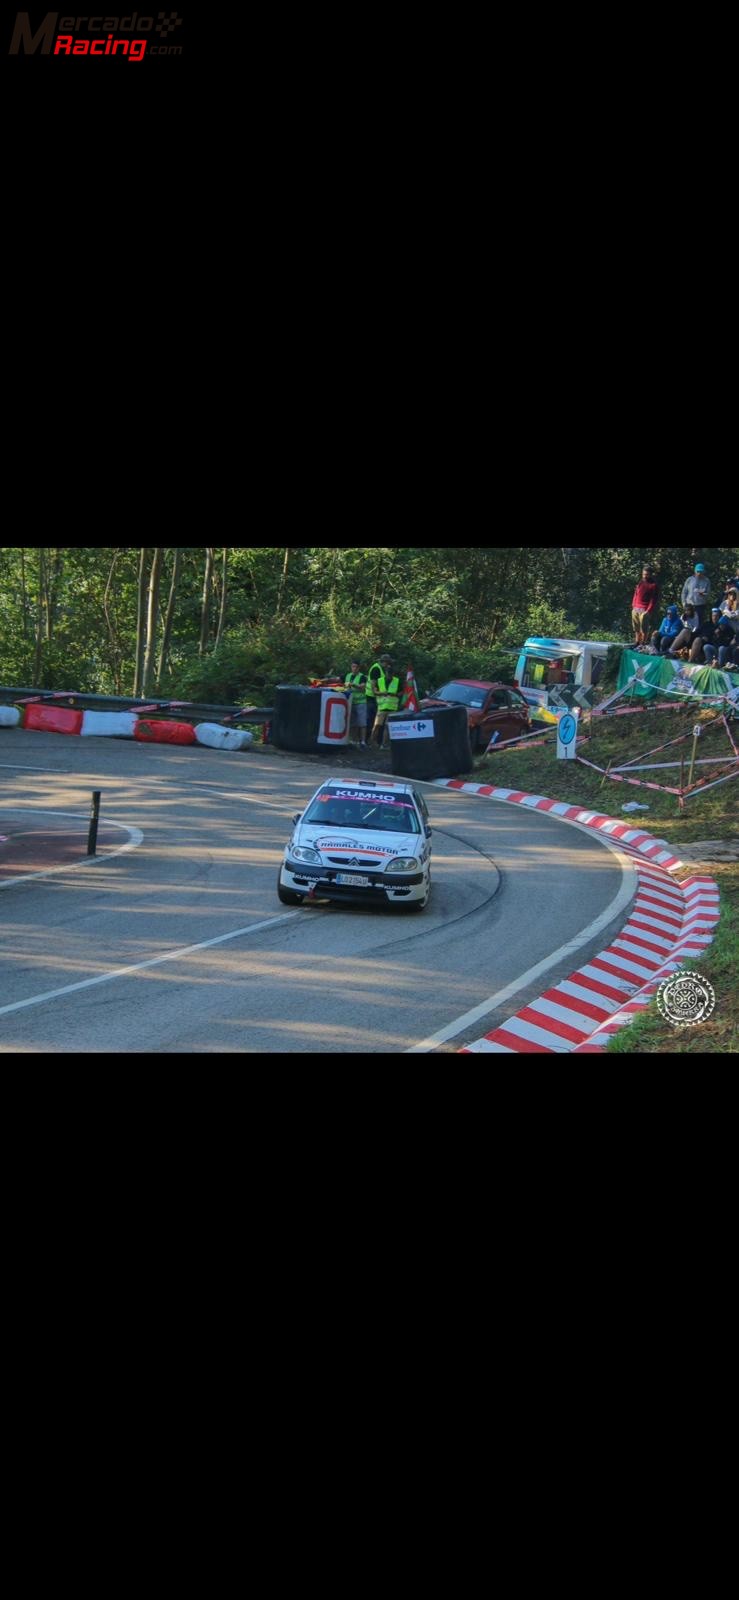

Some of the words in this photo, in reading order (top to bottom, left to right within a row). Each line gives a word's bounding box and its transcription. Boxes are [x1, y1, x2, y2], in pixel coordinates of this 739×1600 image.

[335, 790, 396, 801] KUMHO
[366, 845, 399, 855] MOTOR
[295, 874, 320, 882] KUMHO
